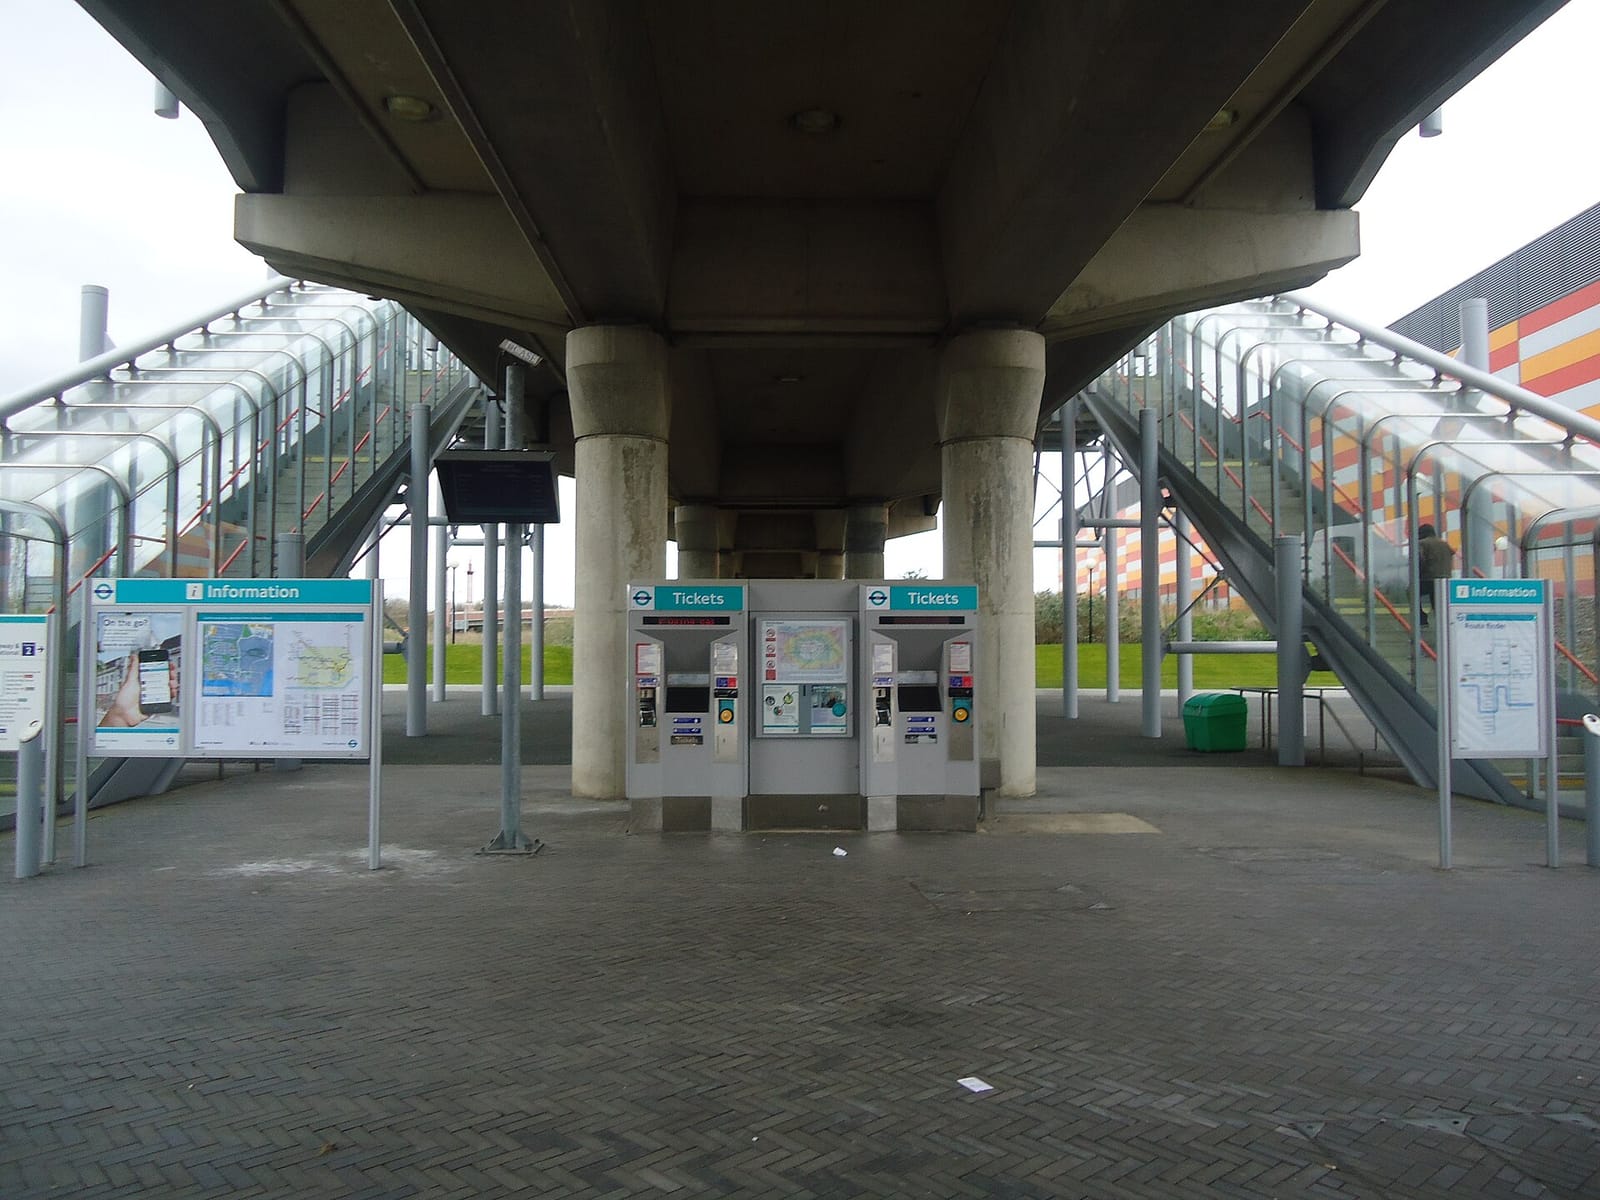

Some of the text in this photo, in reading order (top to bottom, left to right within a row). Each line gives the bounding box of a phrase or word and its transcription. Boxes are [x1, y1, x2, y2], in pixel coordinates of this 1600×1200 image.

[207, 584, 300, 598] Information
[1471, 586, 1537, 597] Information
[672, 592, 725, 605] Tickets
[907, 592, 959, 605] Tickets
[25, 646, 32, 655] 2
